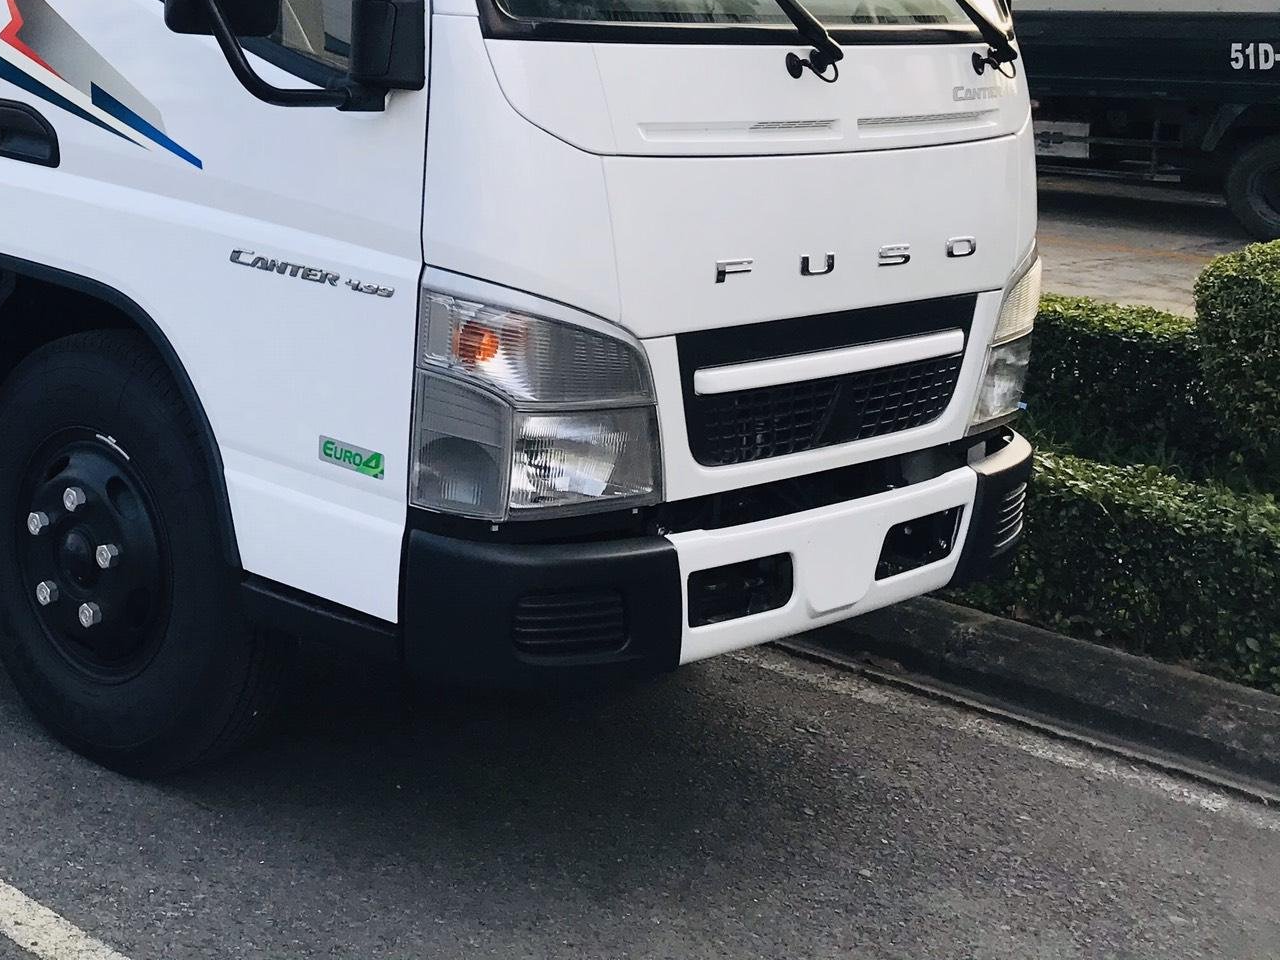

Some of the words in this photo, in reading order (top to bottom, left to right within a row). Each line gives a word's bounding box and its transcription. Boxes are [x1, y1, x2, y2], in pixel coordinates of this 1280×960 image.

[952, 86, 1008, 101] CANTE
[229, 249, 340, 286] CANTER
[715, 236, 976, 284] FUSO
